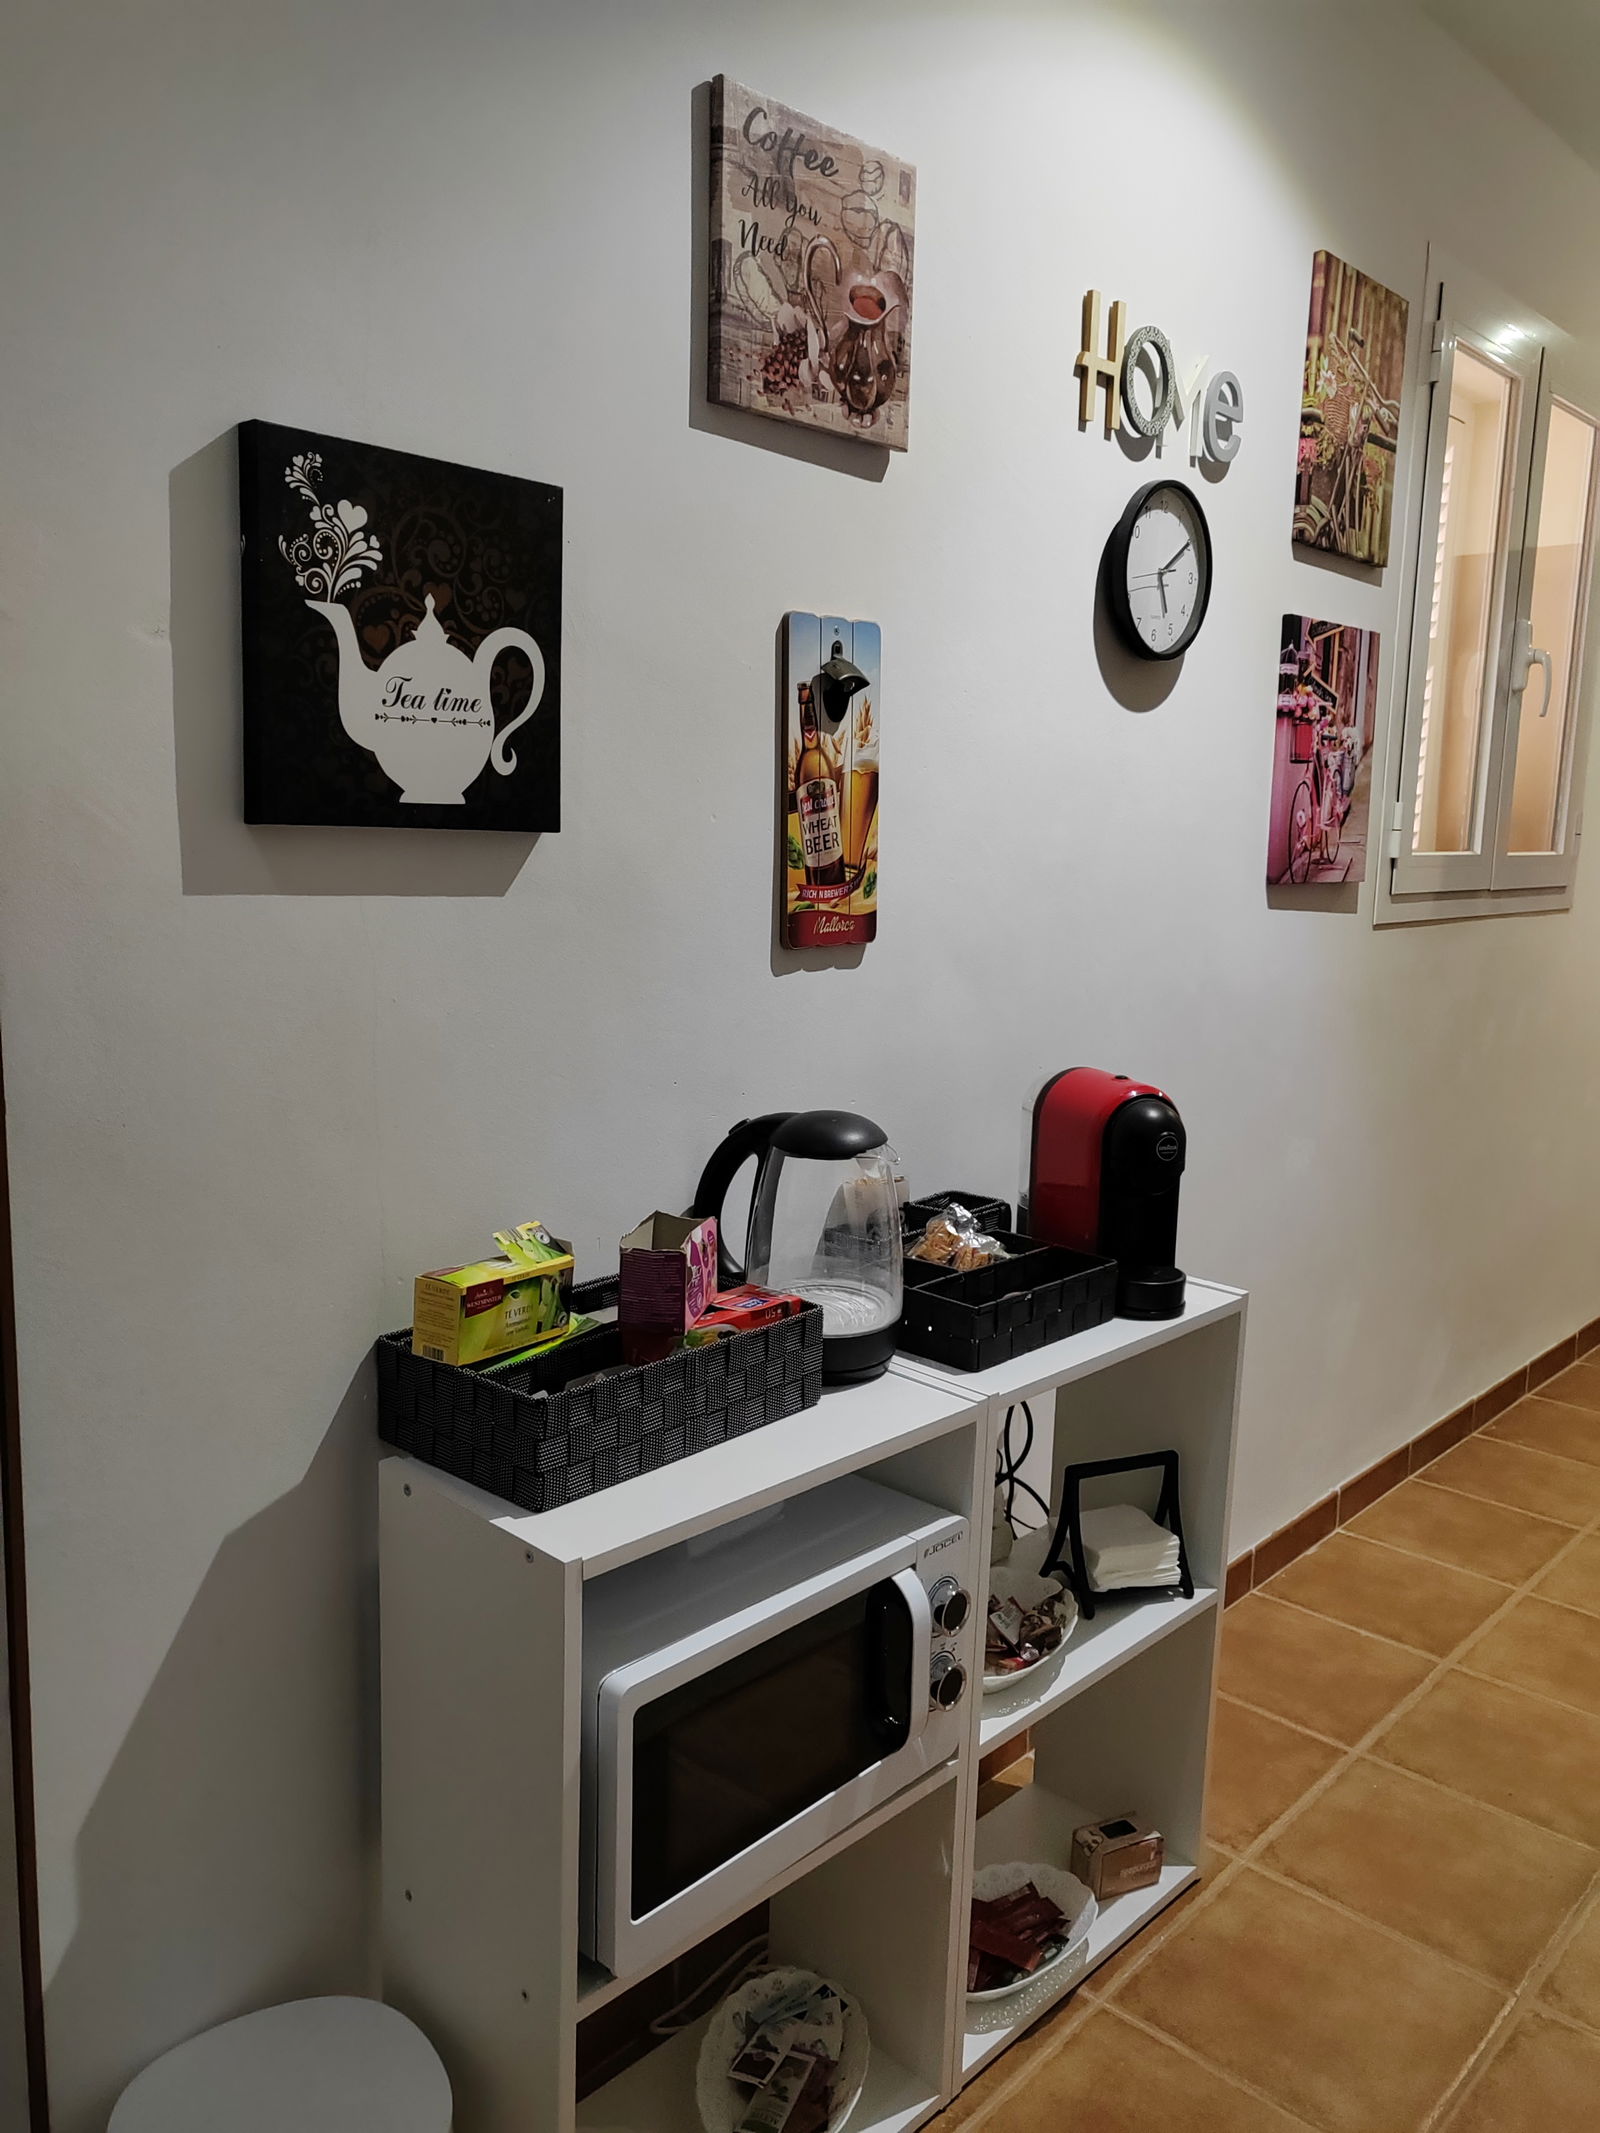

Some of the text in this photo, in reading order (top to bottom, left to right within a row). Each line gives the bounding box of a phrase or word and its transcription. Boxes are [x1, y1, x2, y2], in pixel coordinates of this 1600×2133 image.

[742, 107, 839, 178] Coffee
[742, 172, 822, 228] All you
[738, 217, 790, 262] Need
[1160, 500, 1169, 514] 12
[1188, 572, 1194, 585] 3
[1180, 604, 1187, 617] 4
[1136, 616, 1142, 630] 7
[1168, 623, 1174, 636] 5
[1151, 629, 1157, 642] 6
[382, 676, 482, 713] Tea time
[802, 815, 838, 836] WHEAT
[805, 831, 839, 855] BEER
[801, 889, 818, 899] RICH
[813, 915, 856, 936] Mallorca
